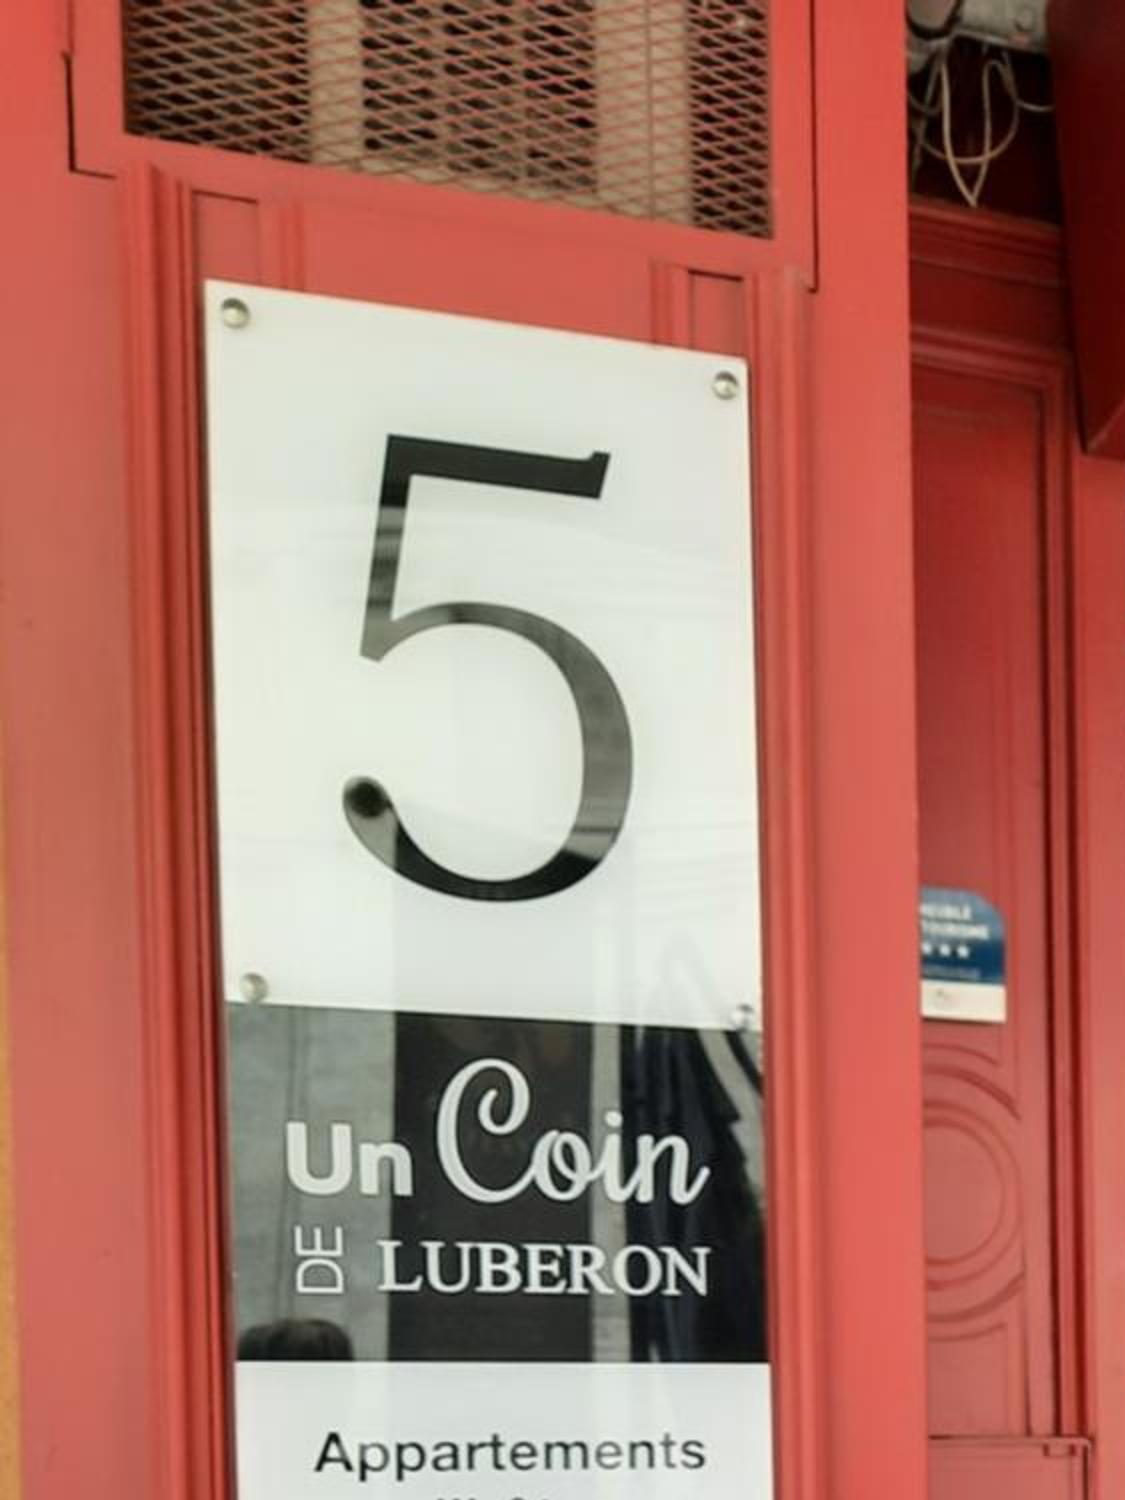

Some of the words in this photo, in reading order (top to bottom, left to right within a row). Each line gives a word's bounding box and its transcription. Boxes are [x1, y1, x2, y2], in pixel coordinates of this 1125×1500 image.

[343, 434, 633, 902] 5
[287, 1121, 413, 1196] Un
[437, 1058, 711, 1205] Coin
[294, 1226, 344, 1294] DE
[378, 1240, 711, 1296] LUBERON
[315, 1432, 707, 1482] Appartements
